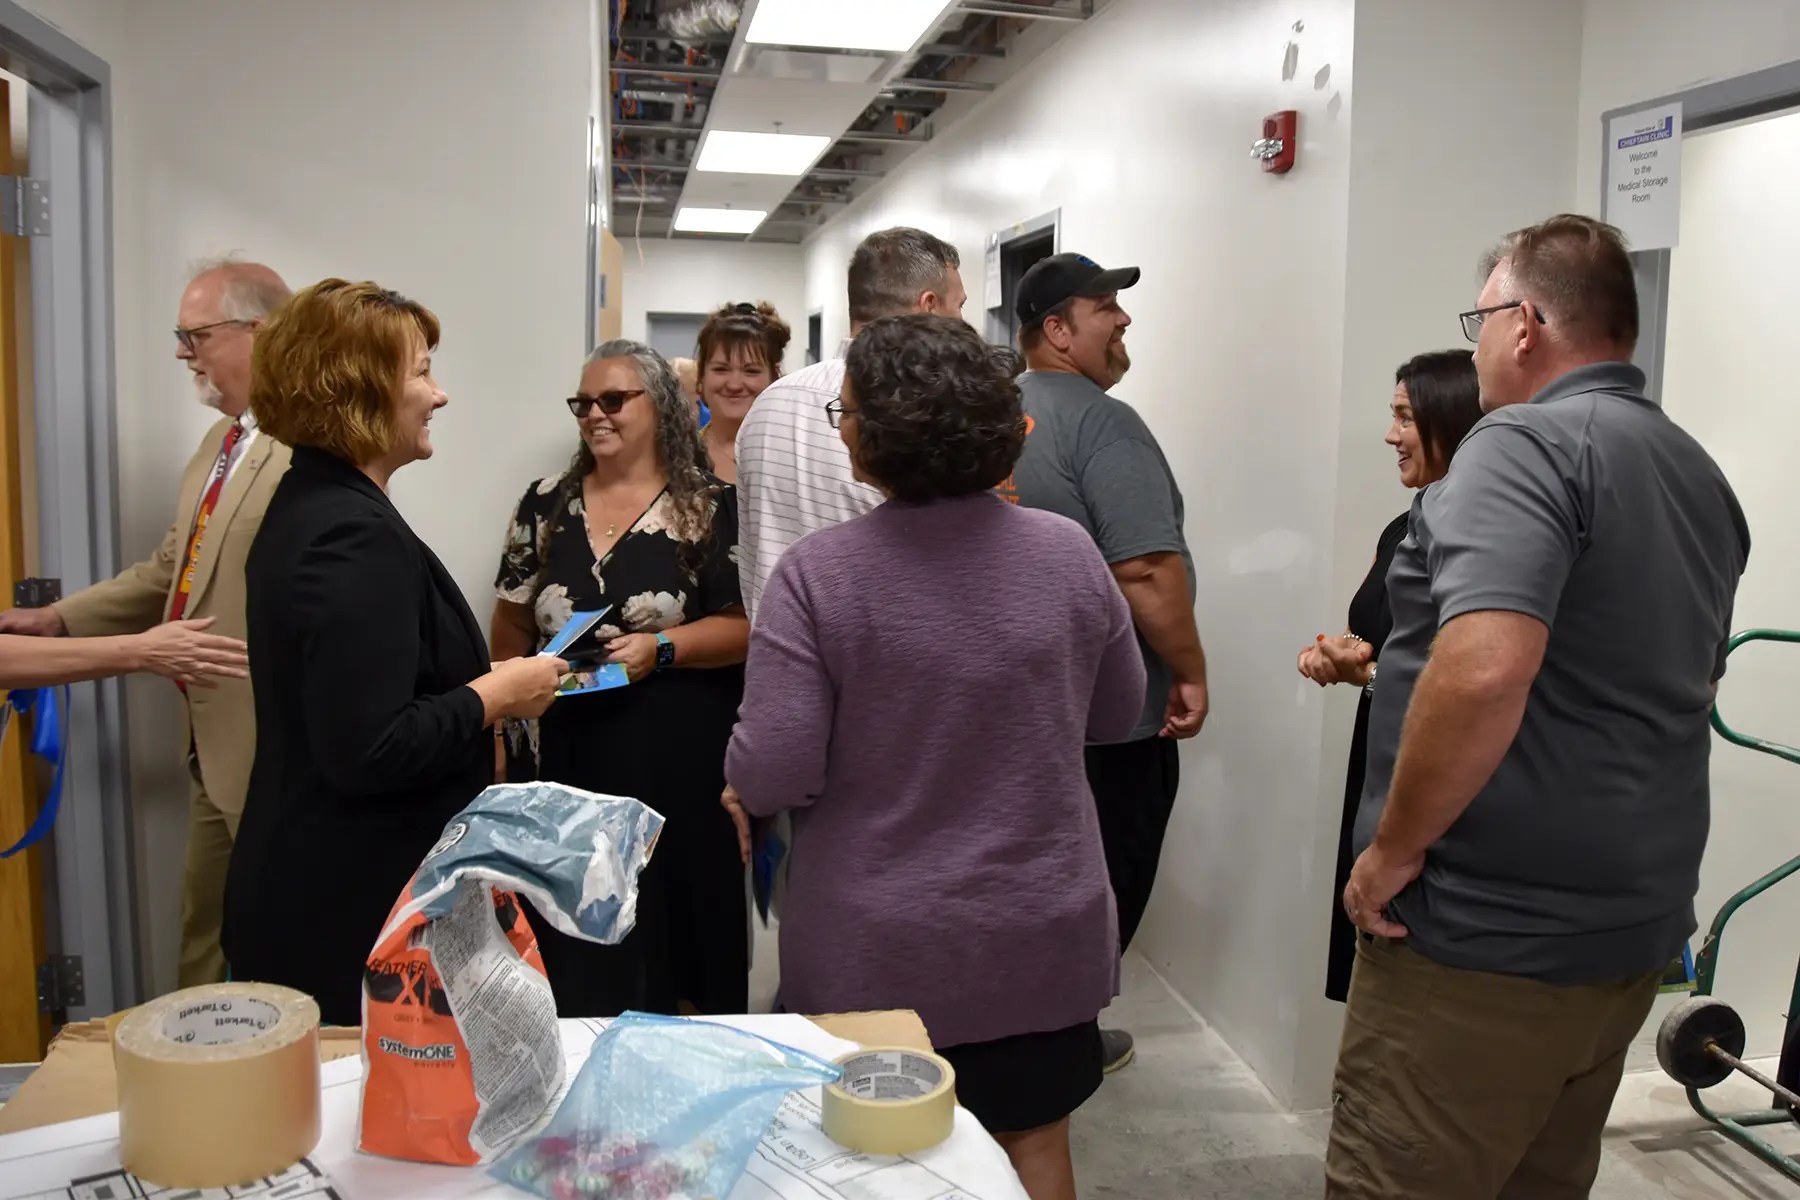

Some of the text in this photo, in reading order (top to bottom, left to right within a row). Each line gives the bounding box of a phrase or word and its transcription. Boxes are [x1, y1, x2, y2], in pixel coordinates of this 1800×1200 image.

[1620, 129, 1670, 148] CHIEFTAIN CLINIC
[1629, 150, 1658, 163] Welcome
[1634, 165, 1651, 176] to the
[1617, 176, 1668, 192] Medical Storage
[1632, 193, 1650, 203] Room
[179, 1002, 218, 1020] Tarkett
[214, 1016, 254, 1028] Tarkett
